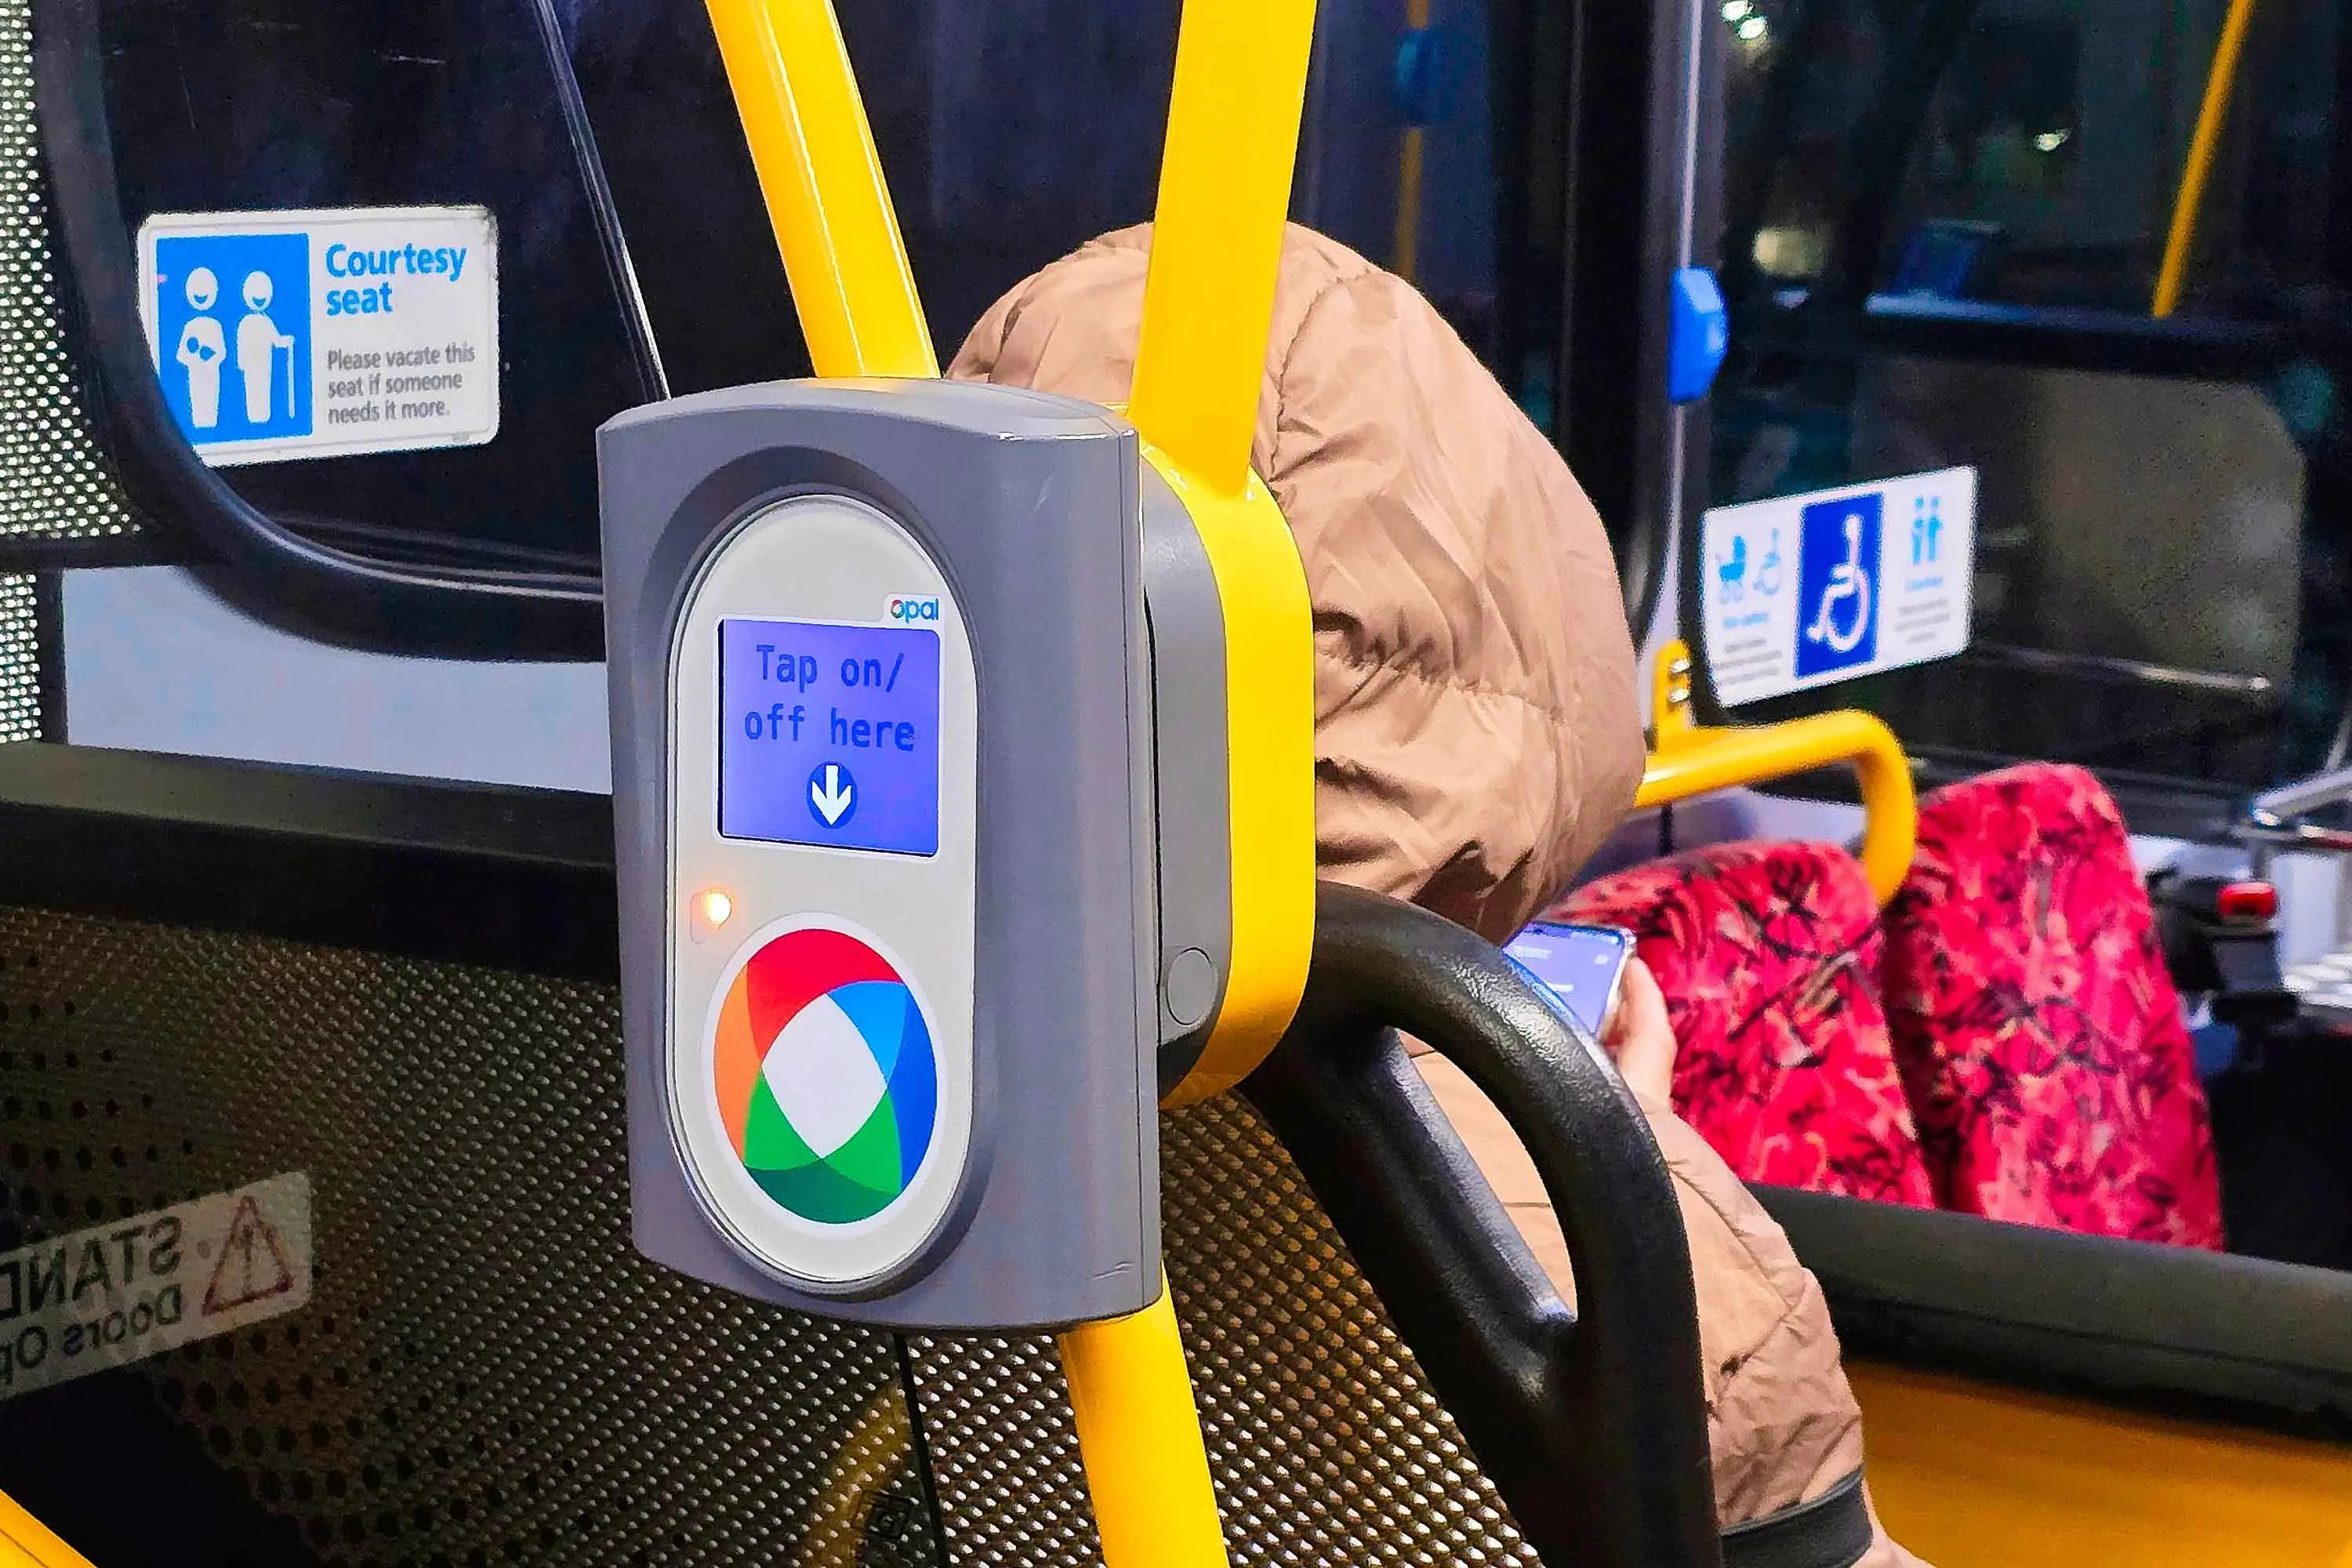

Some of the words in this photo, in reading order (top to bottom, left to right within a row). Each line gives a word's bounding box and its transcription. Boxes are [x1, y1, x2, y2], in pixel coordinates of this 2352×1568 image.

[325, 242, 468, 282] Courtesy
[326, 282, 394, 316] seat
[328, 348, 382, 371] Please
[385, 346, 442, 367] vacate
[445, 342, 476, 363] this
[328, 377, 365, 399] seat
[368, 372, 383, 394] if
[386, 372, 463, 394] someone
[328, 401, 380, 424] needs
[384, 400, 398, 420] it
[401, 400, 451, 420] more.
[890, 598, 939, 623] opal
[756, 644, 818, 693] Tap
[840, 652, 904, 692] on/
[744, 702, 804, 741] off
[830, 707, 916, 752] here
